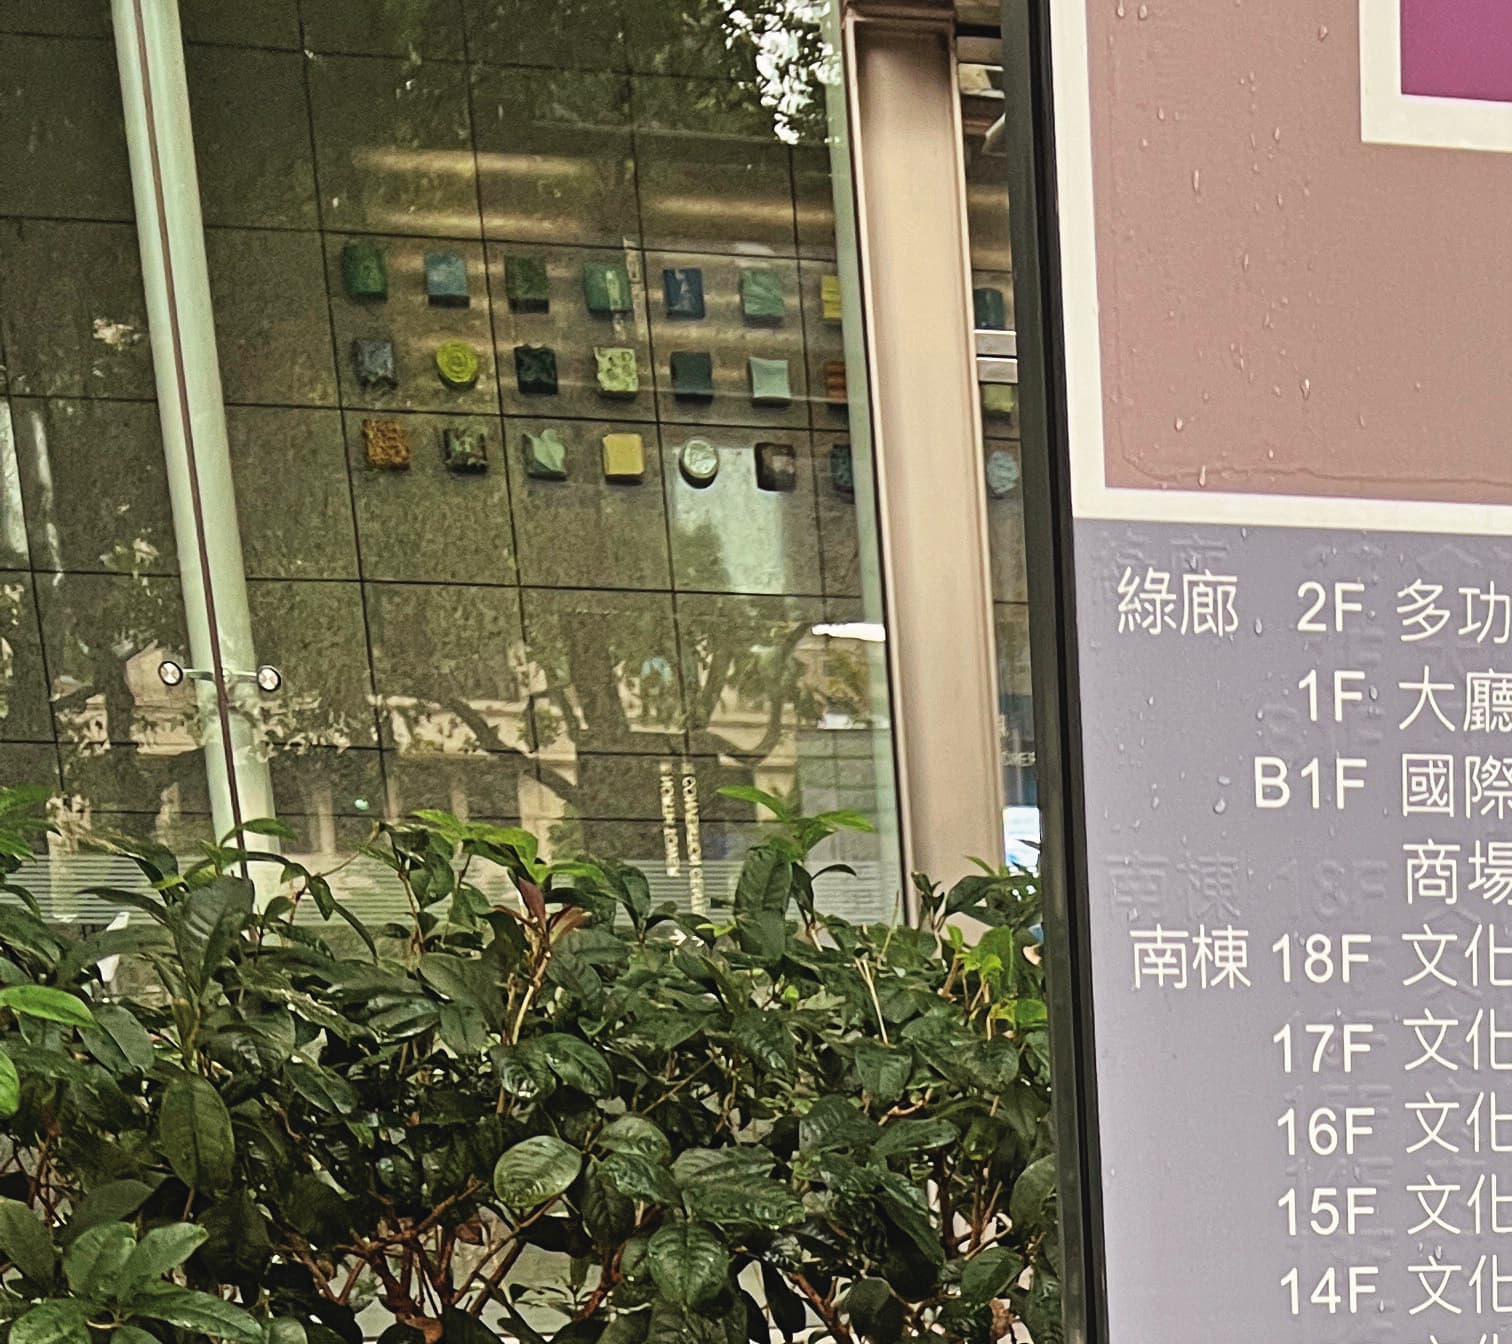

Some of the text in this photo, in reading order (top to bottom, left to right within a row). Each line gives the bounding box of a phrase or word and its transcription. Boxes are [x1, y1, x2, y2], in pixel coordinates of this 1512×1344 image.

[1118, 566, 1238, 636] 綠廊
[1298, 582, 1364, 631] 2F
[1299, 670, 1365, 721] 1F
[1255, 756, 1367, 809] B1F
[1130, 924, 1251, 989] 南棟
[1273, 934, 1371, 983] 18F
[1274, 1024, 1373, 1072] 17F
[1278, 1108, 1375, 1155] 16F
[1279, 1188, 1376, 1235] 15F
[1281, 1267, 1379, 1314] 14F
